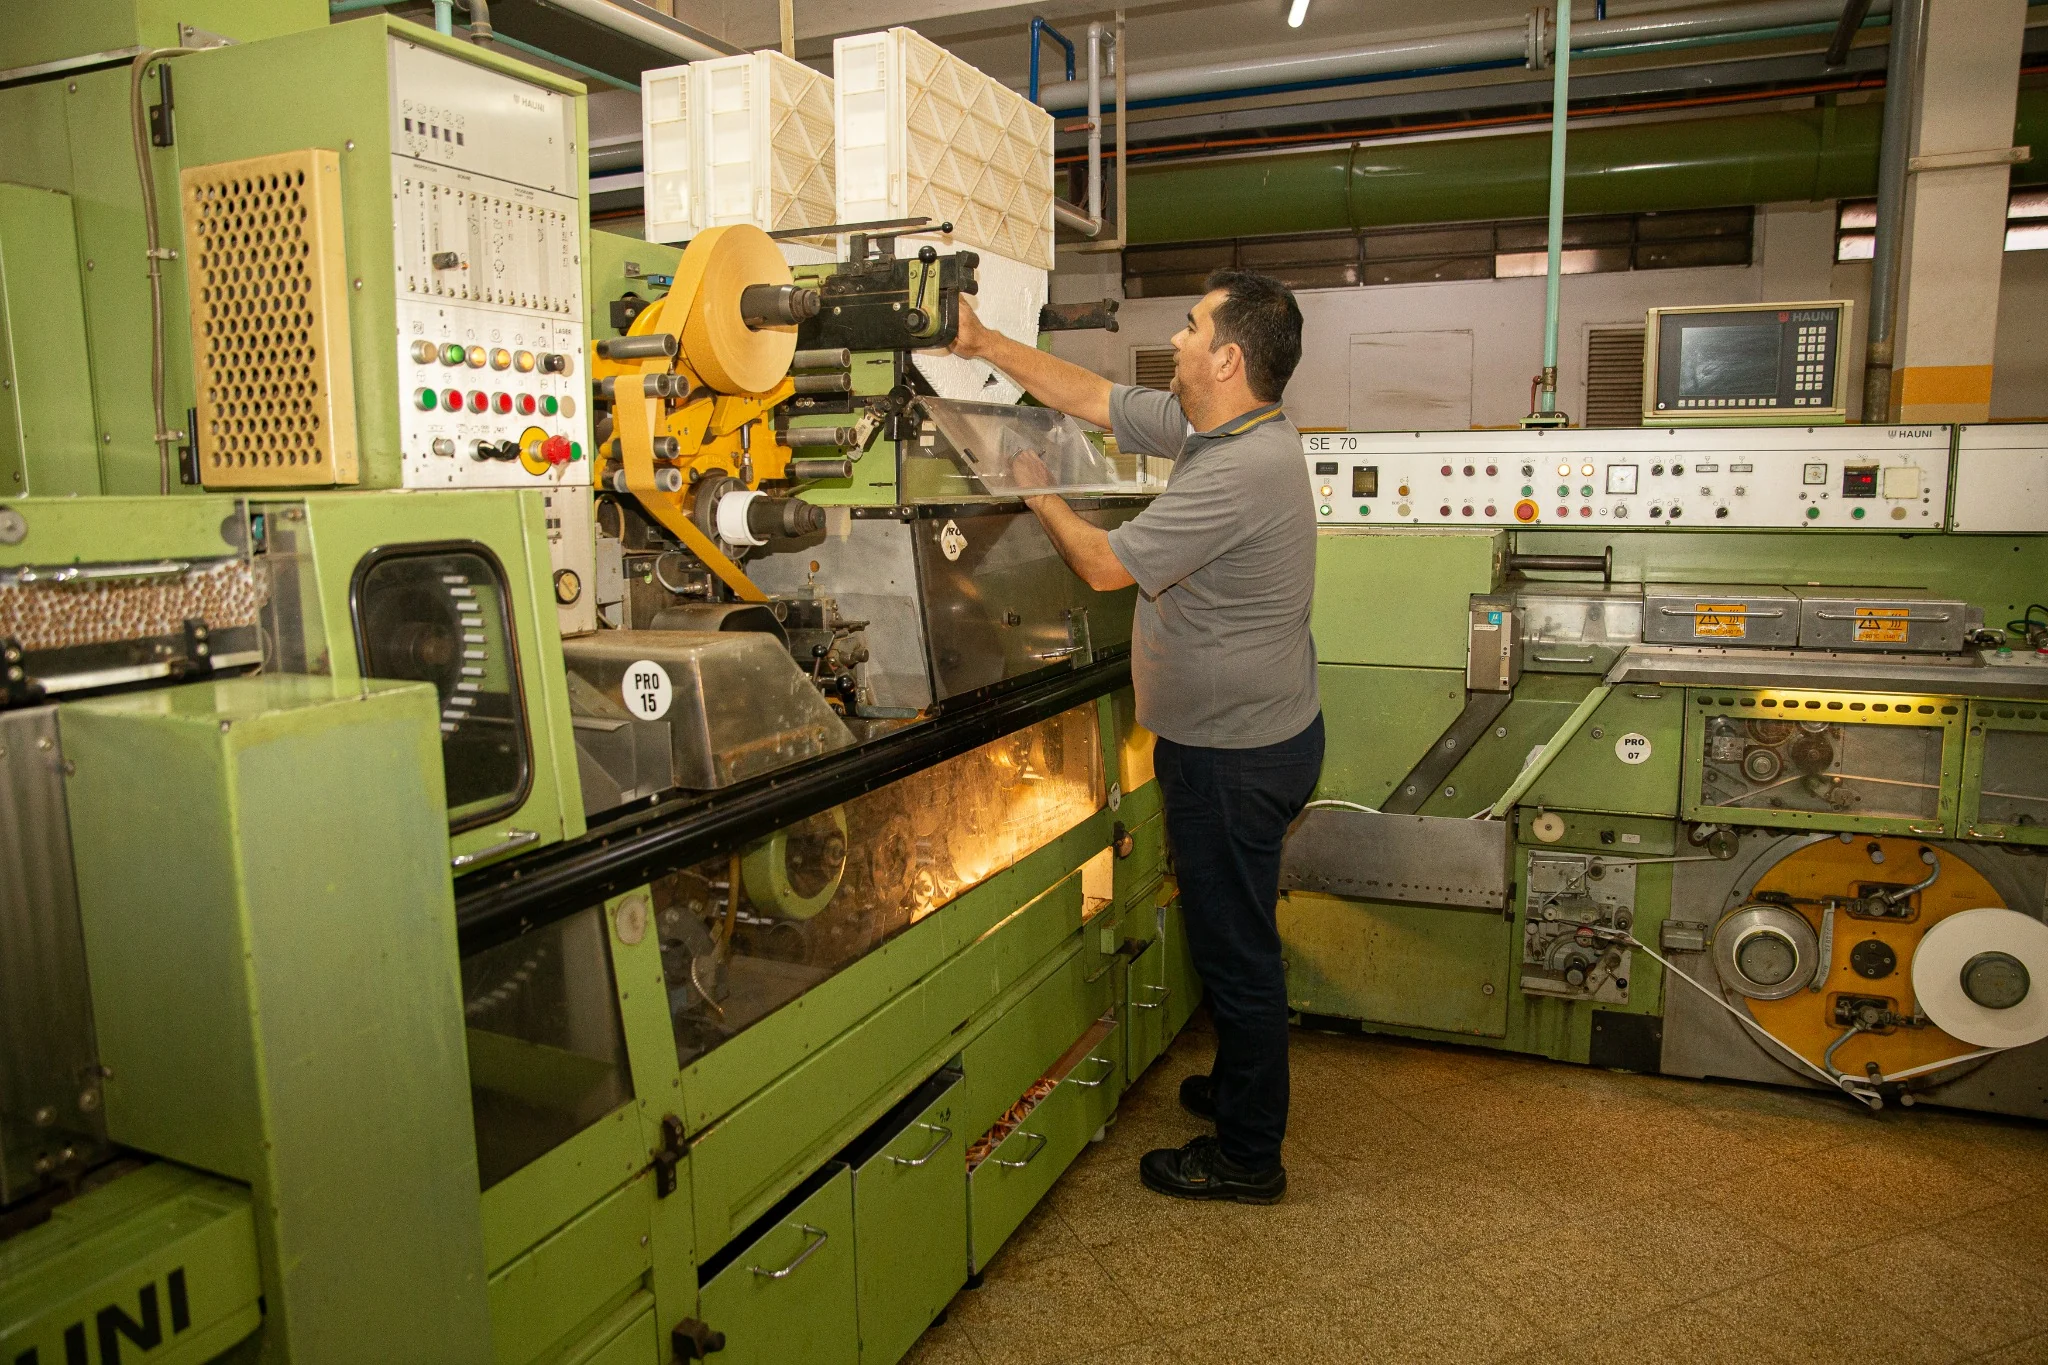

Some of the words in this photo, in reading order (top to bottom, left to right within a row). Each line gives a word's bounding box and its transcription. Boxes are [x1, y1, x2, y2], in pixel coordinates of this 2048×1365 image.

[1792, 311, 1834, 321] HAUNI
[1899, 430, 1932, 438] HAUNI
[1309, 437, 1330, 450] SE
[1339, 437, 1357, 450] 70
[949, 544, 957, 554] 13
[634, 673, 660, 690] PRO
[640, 693, 657, 712] 15
[1624, 738, 1645, 746] PRO
[1628, 752, 1640, 760] 07
